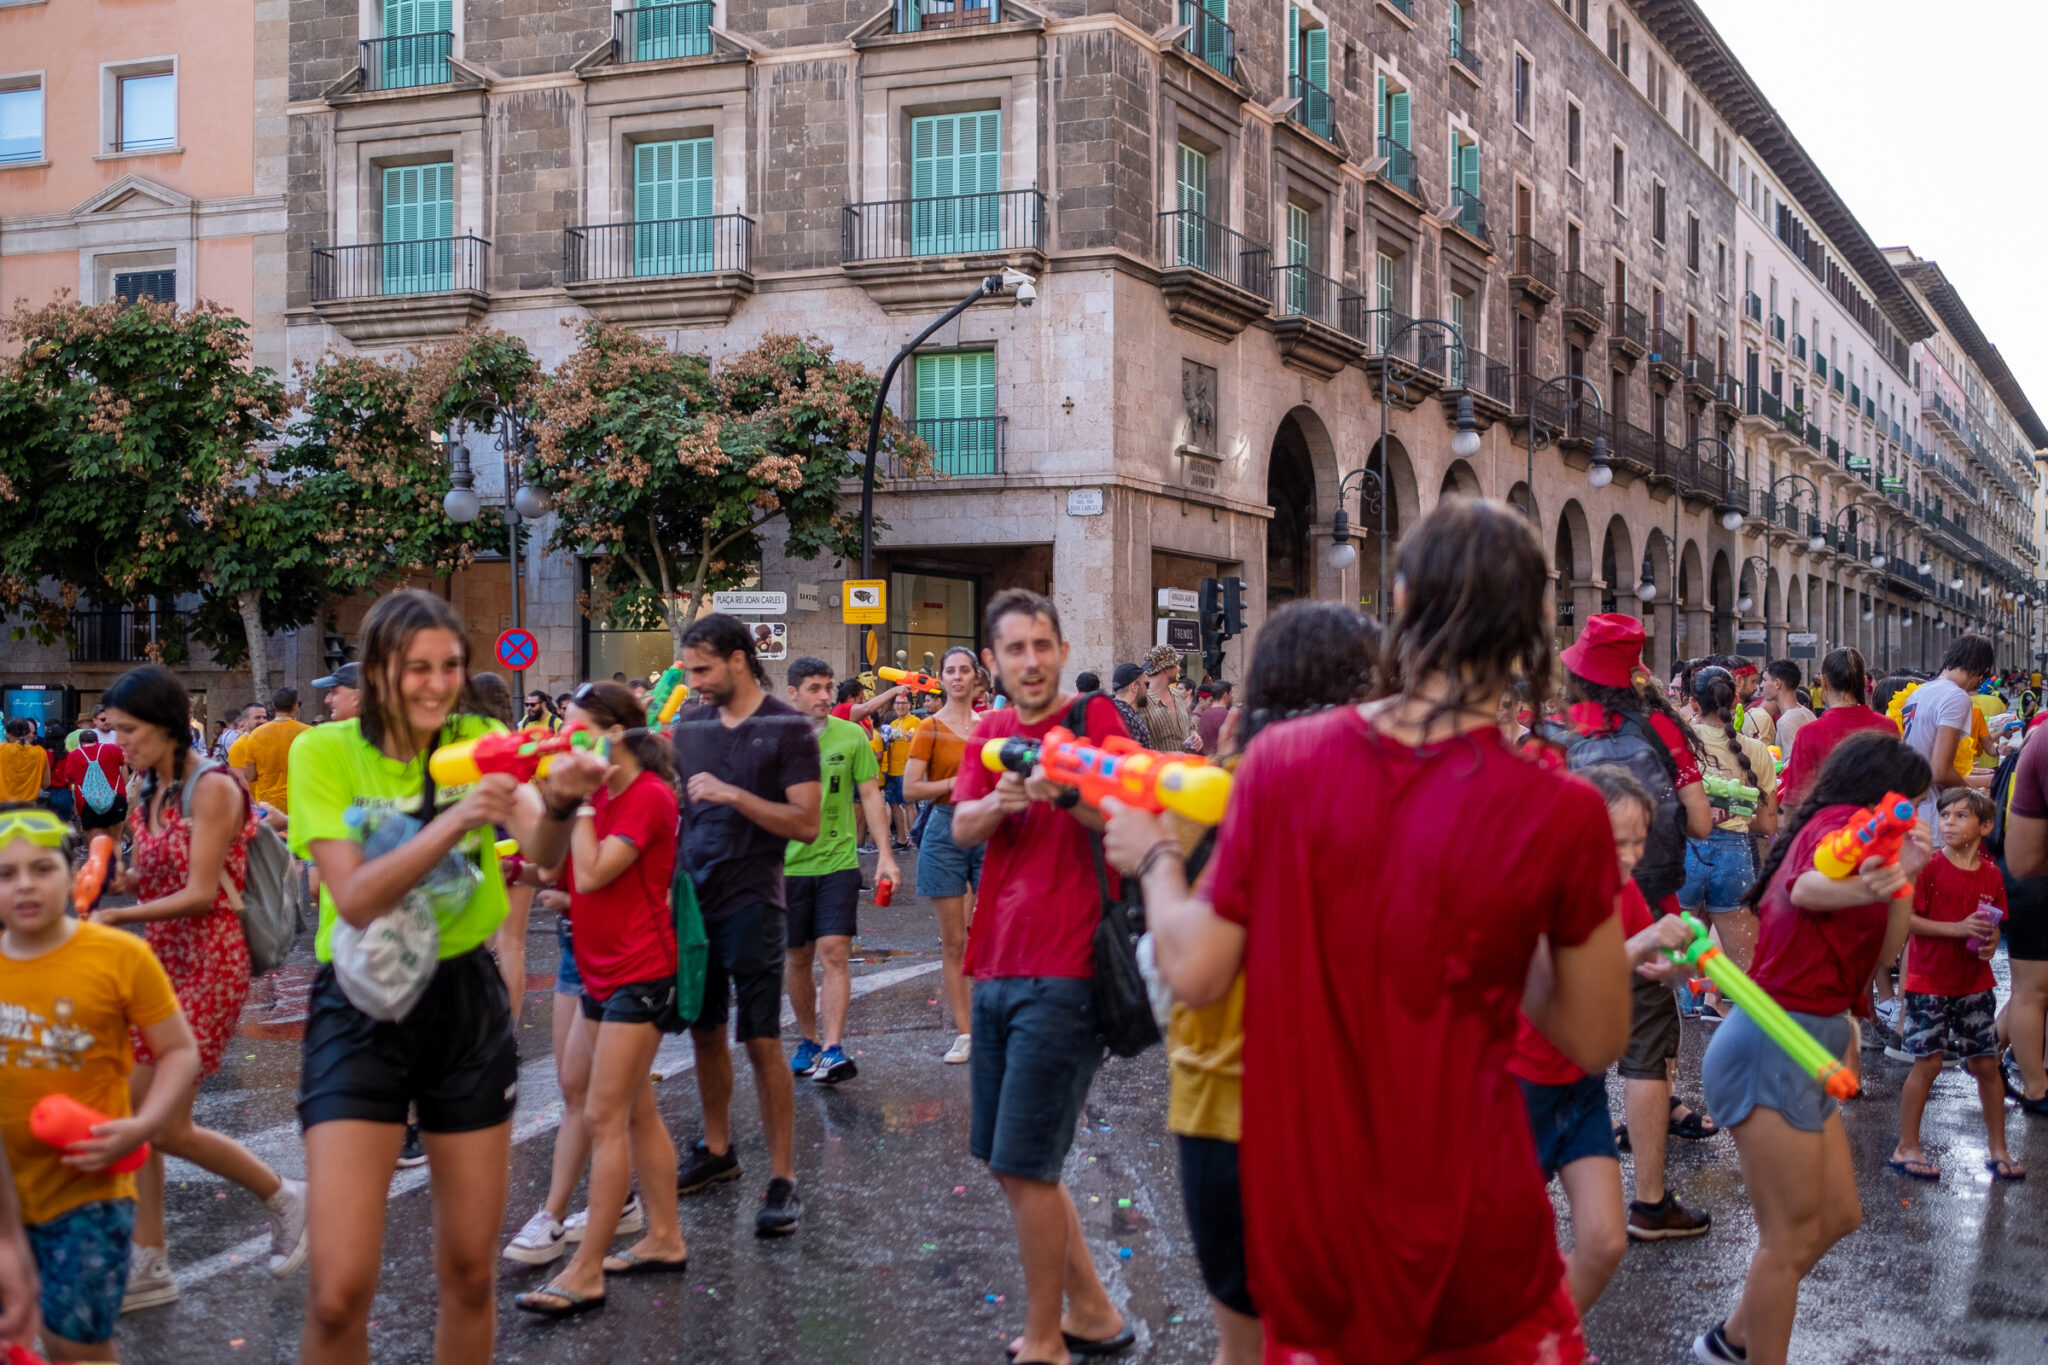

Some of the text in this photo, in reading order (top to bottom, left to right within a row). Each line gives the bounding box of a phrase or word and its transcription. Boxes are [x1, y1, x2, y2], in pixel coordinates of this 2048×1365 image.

[716, 595, 734, 605] PLAÇA
[735, 595, 743, 604] REI
[744, 595, 760, 604] JOAN
[761, 595, 781, 604] CARLES
